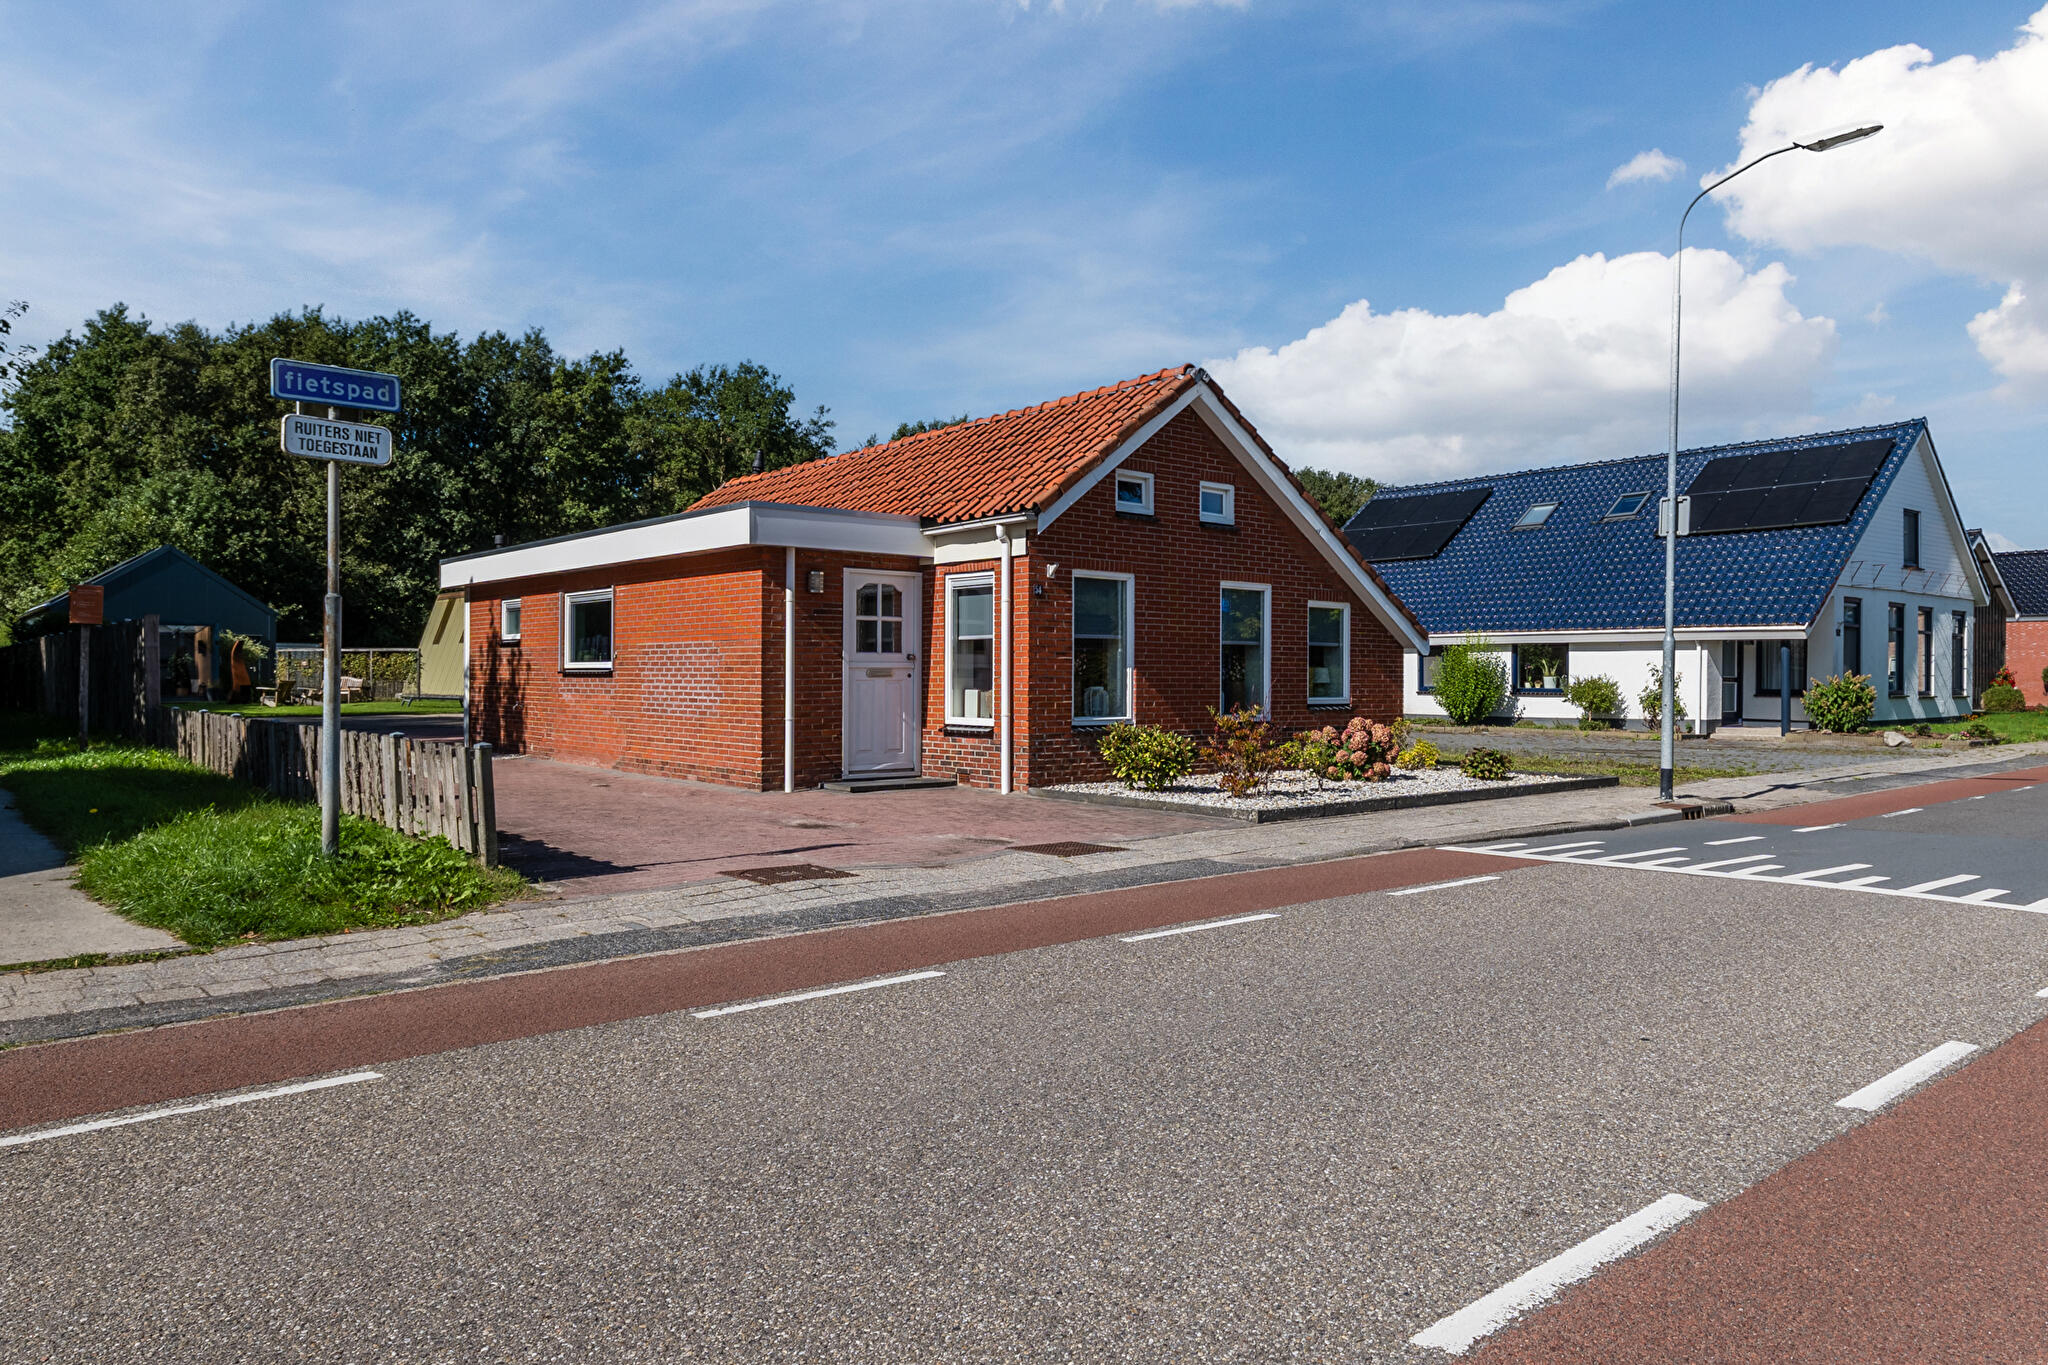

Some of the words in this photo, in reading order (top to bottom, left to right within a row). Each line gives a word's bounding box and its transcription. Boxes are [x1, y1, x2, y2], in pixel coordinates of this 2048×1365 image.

[284, 371, 390, 402] fietspad
[295, 421, 350, 440] RUITERS
[355, 429, 382, 444] NIET
[298, 437, 378, 459] TOEGESTAAN
